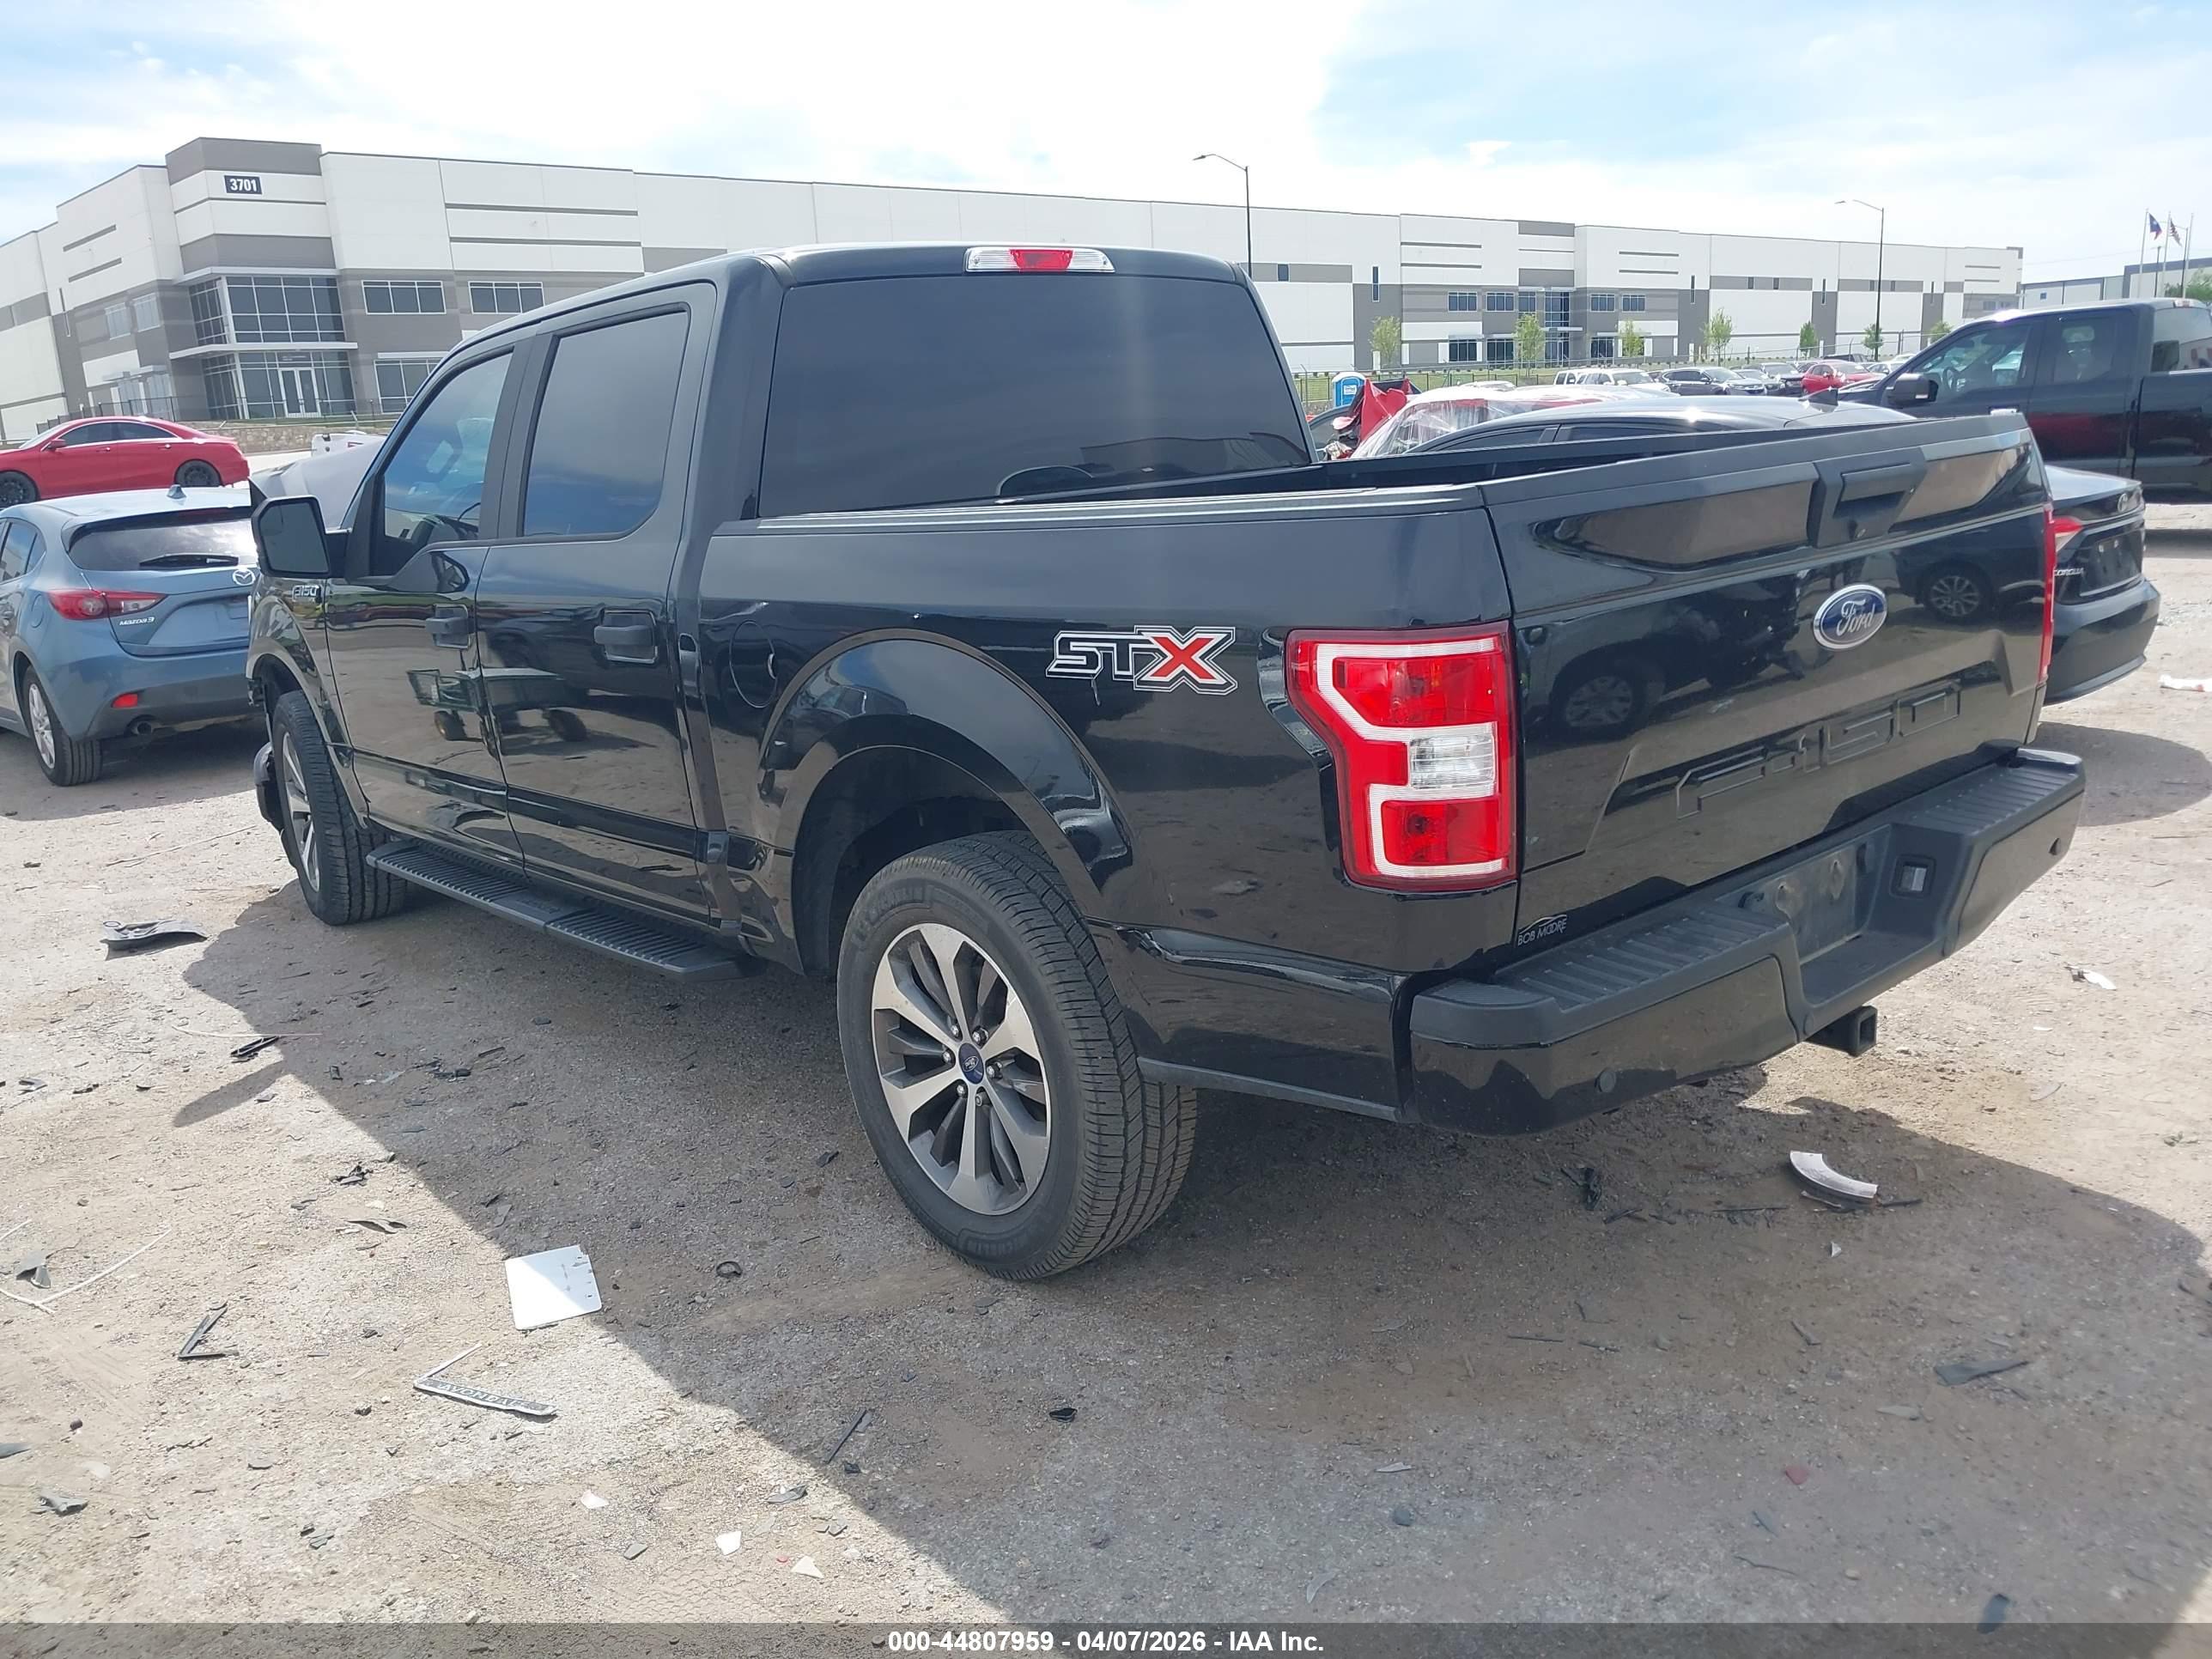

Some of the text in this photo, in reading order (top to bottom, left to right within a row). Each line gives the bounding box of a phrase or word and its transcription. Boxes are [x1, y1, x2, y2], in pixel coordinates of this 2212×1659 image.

[229, 178, 257, 191] 3701
[1836, 599, 1875, 636] Ford
[1045, 625, 1238, 696] STX
[1517, 918, 1567, 945] BOB MOORE
